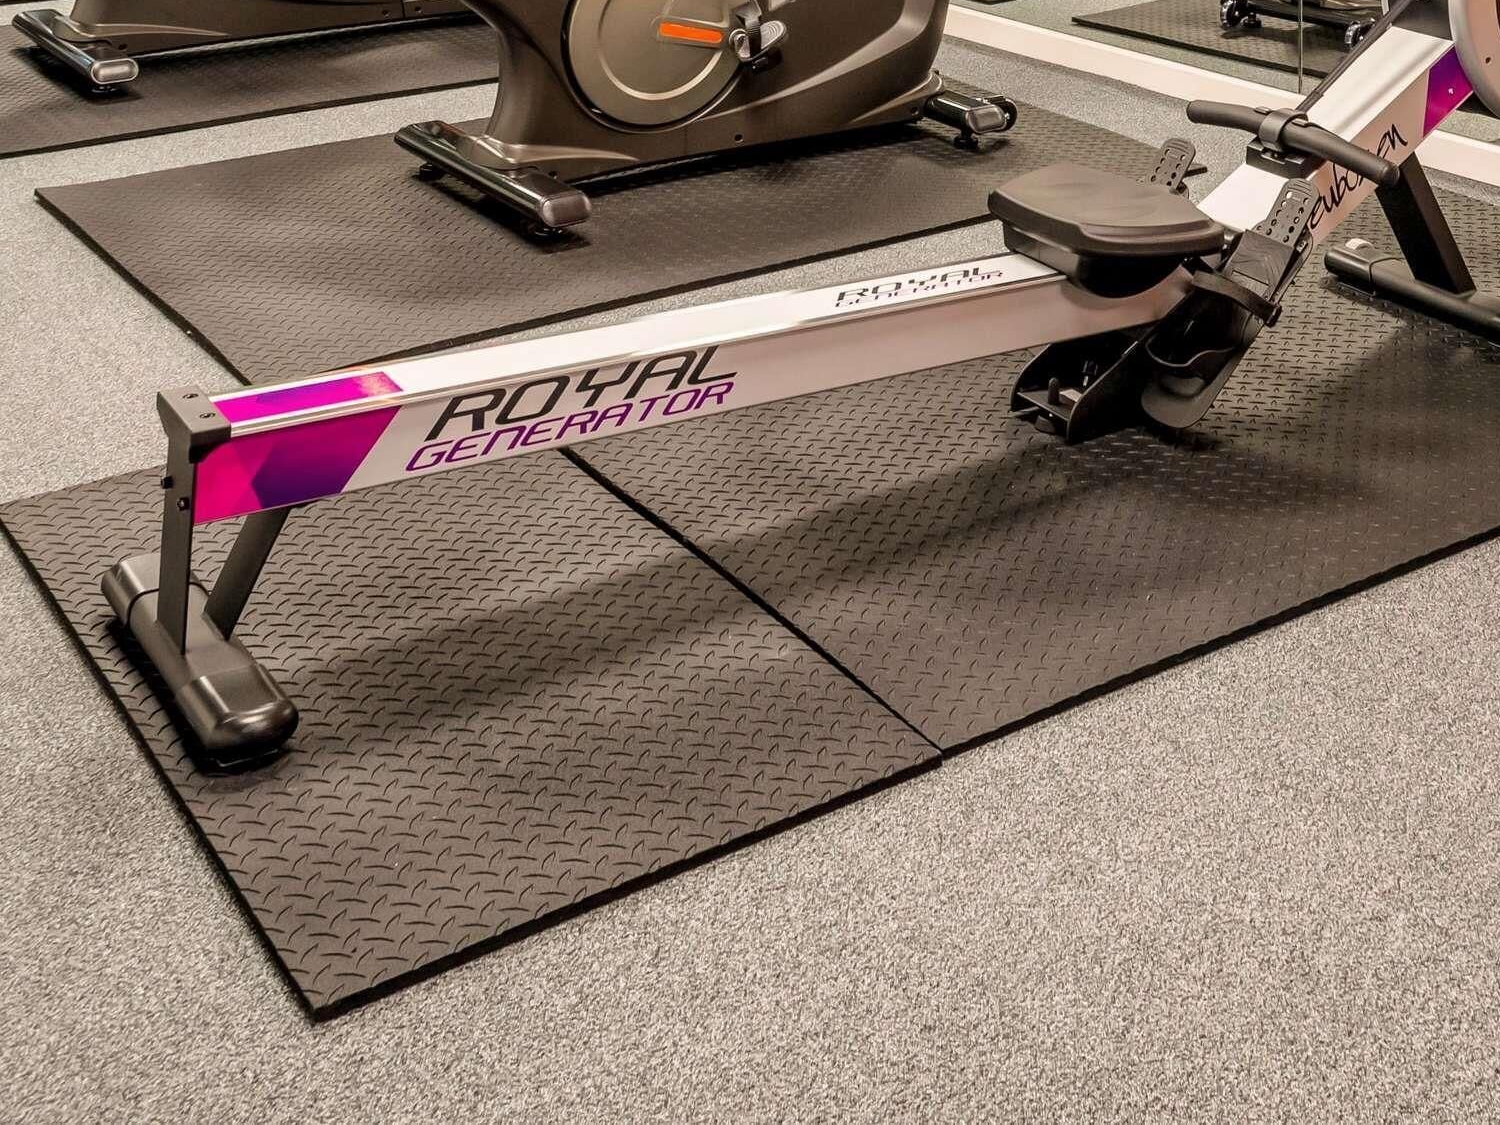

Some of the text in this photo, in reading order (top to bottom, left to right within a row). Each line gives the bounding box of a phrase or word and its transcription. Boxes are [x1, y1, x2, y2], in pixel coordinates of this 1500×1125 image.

[837, 267, 998, 302] ROYAL
[405, 381, 735, 472] GENERATOR
[424, 345, 738, 442] ROYAL
